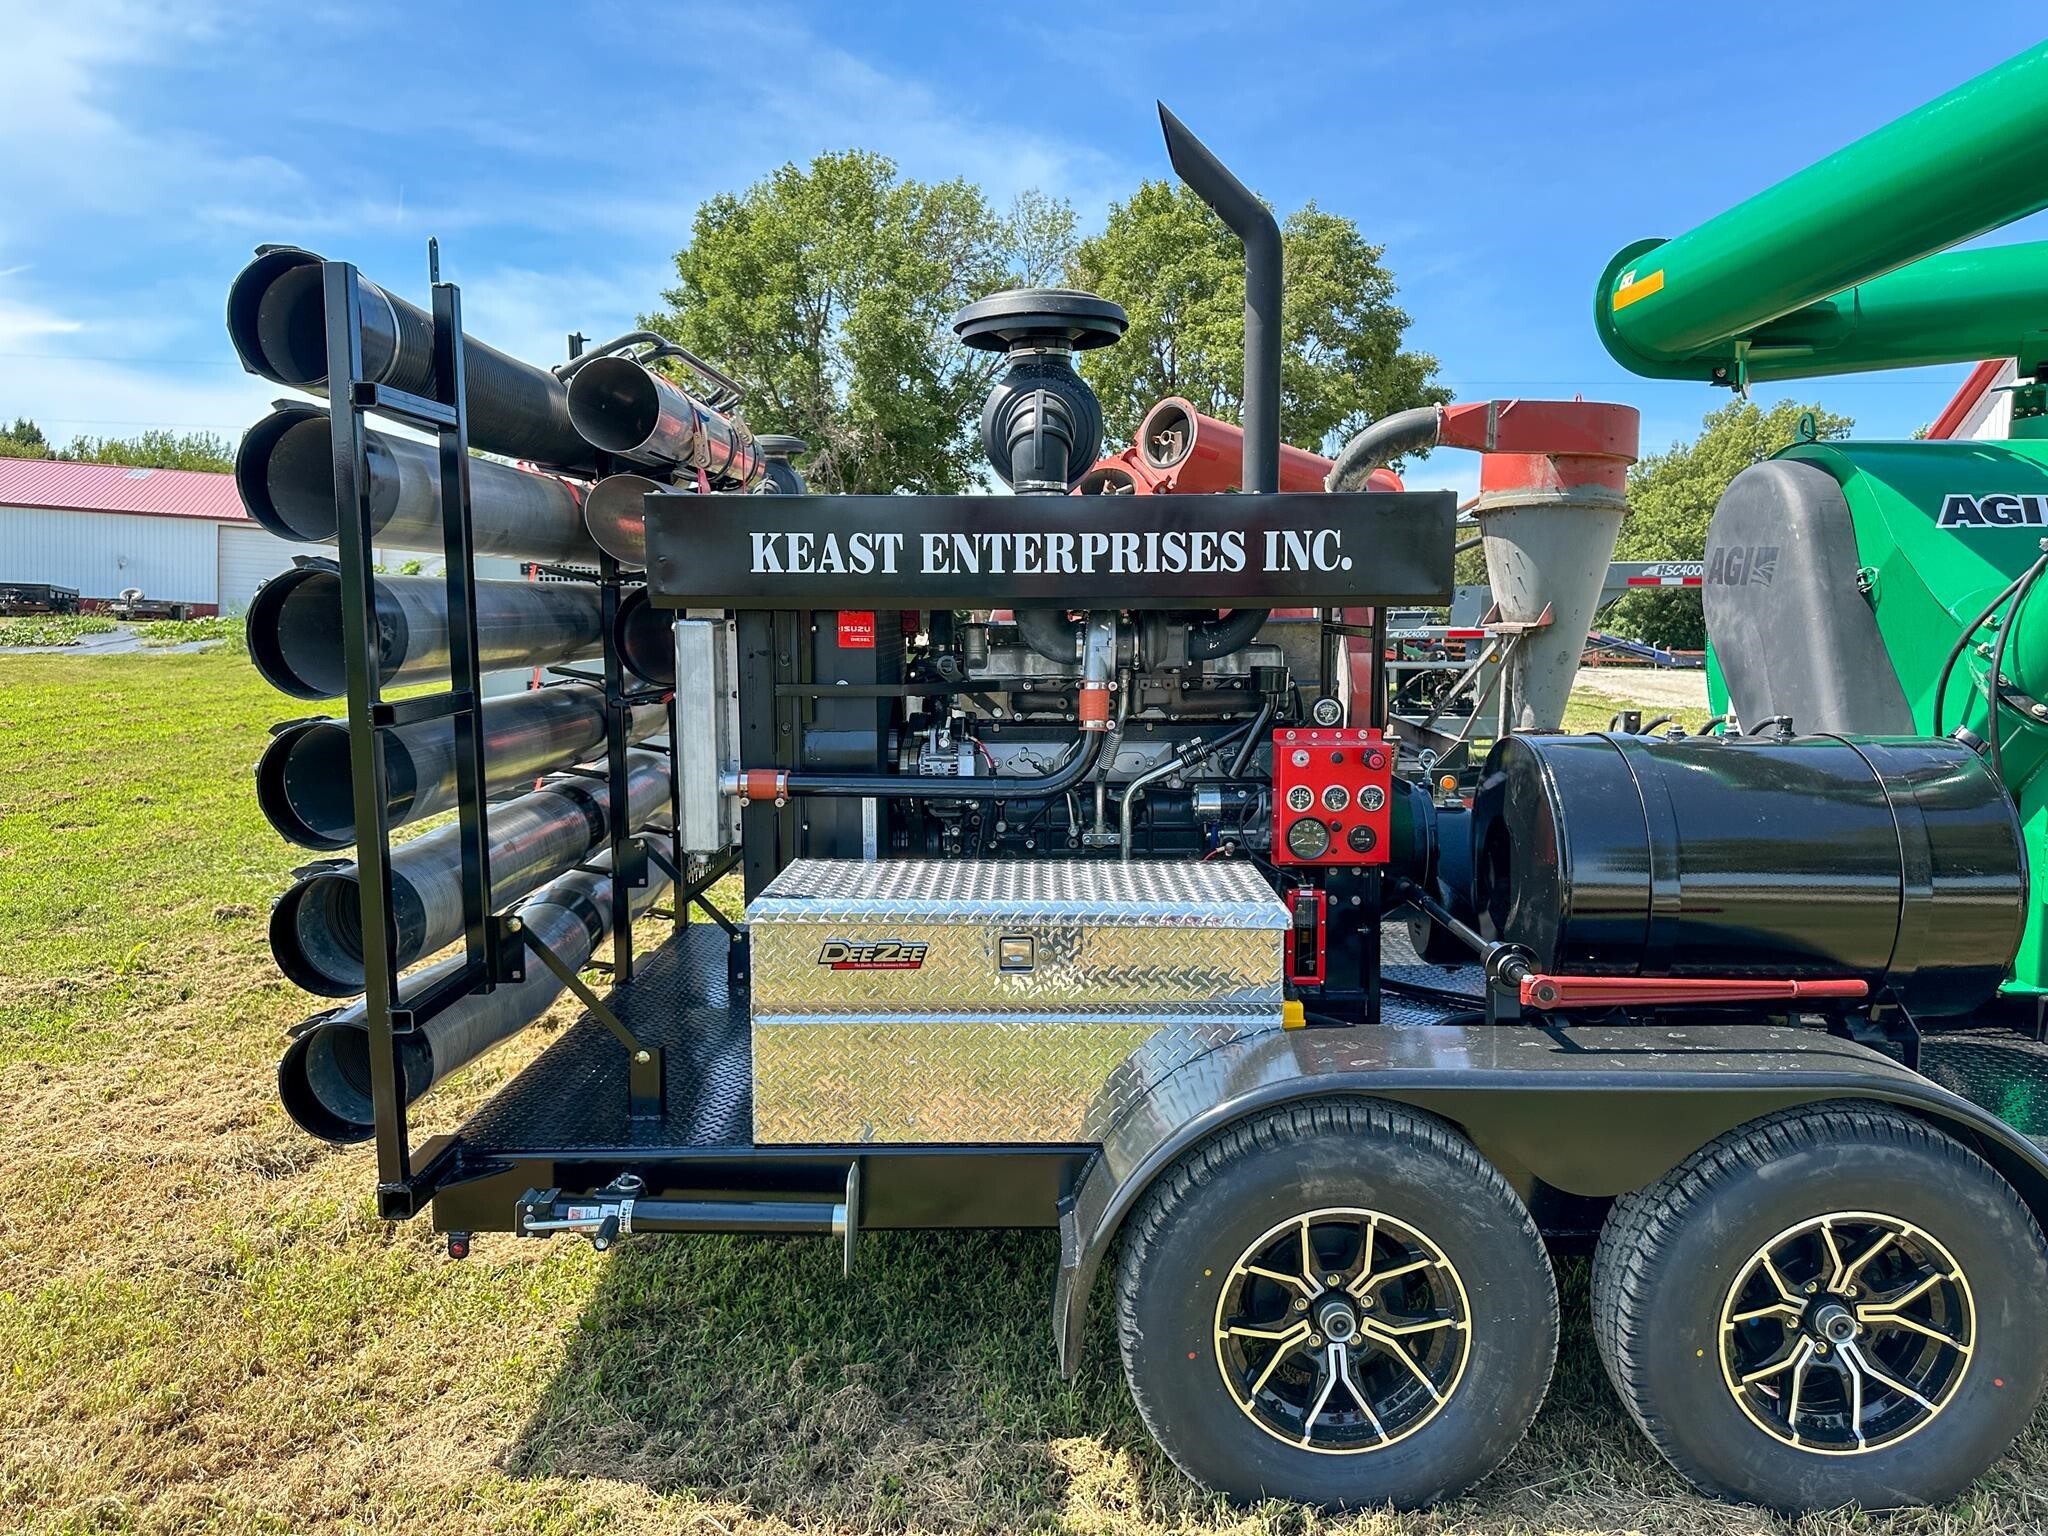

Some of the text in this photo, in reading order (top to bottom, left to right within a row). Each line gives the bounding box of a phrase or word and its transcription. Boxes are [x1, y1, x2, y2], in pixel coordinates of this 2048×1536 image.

[1937, 494, 2046, 528] AGI
[749, 529, 1353, 574] KEAST ENTERPRISES INC.
[1707, 546, 1755, 586] AGI
